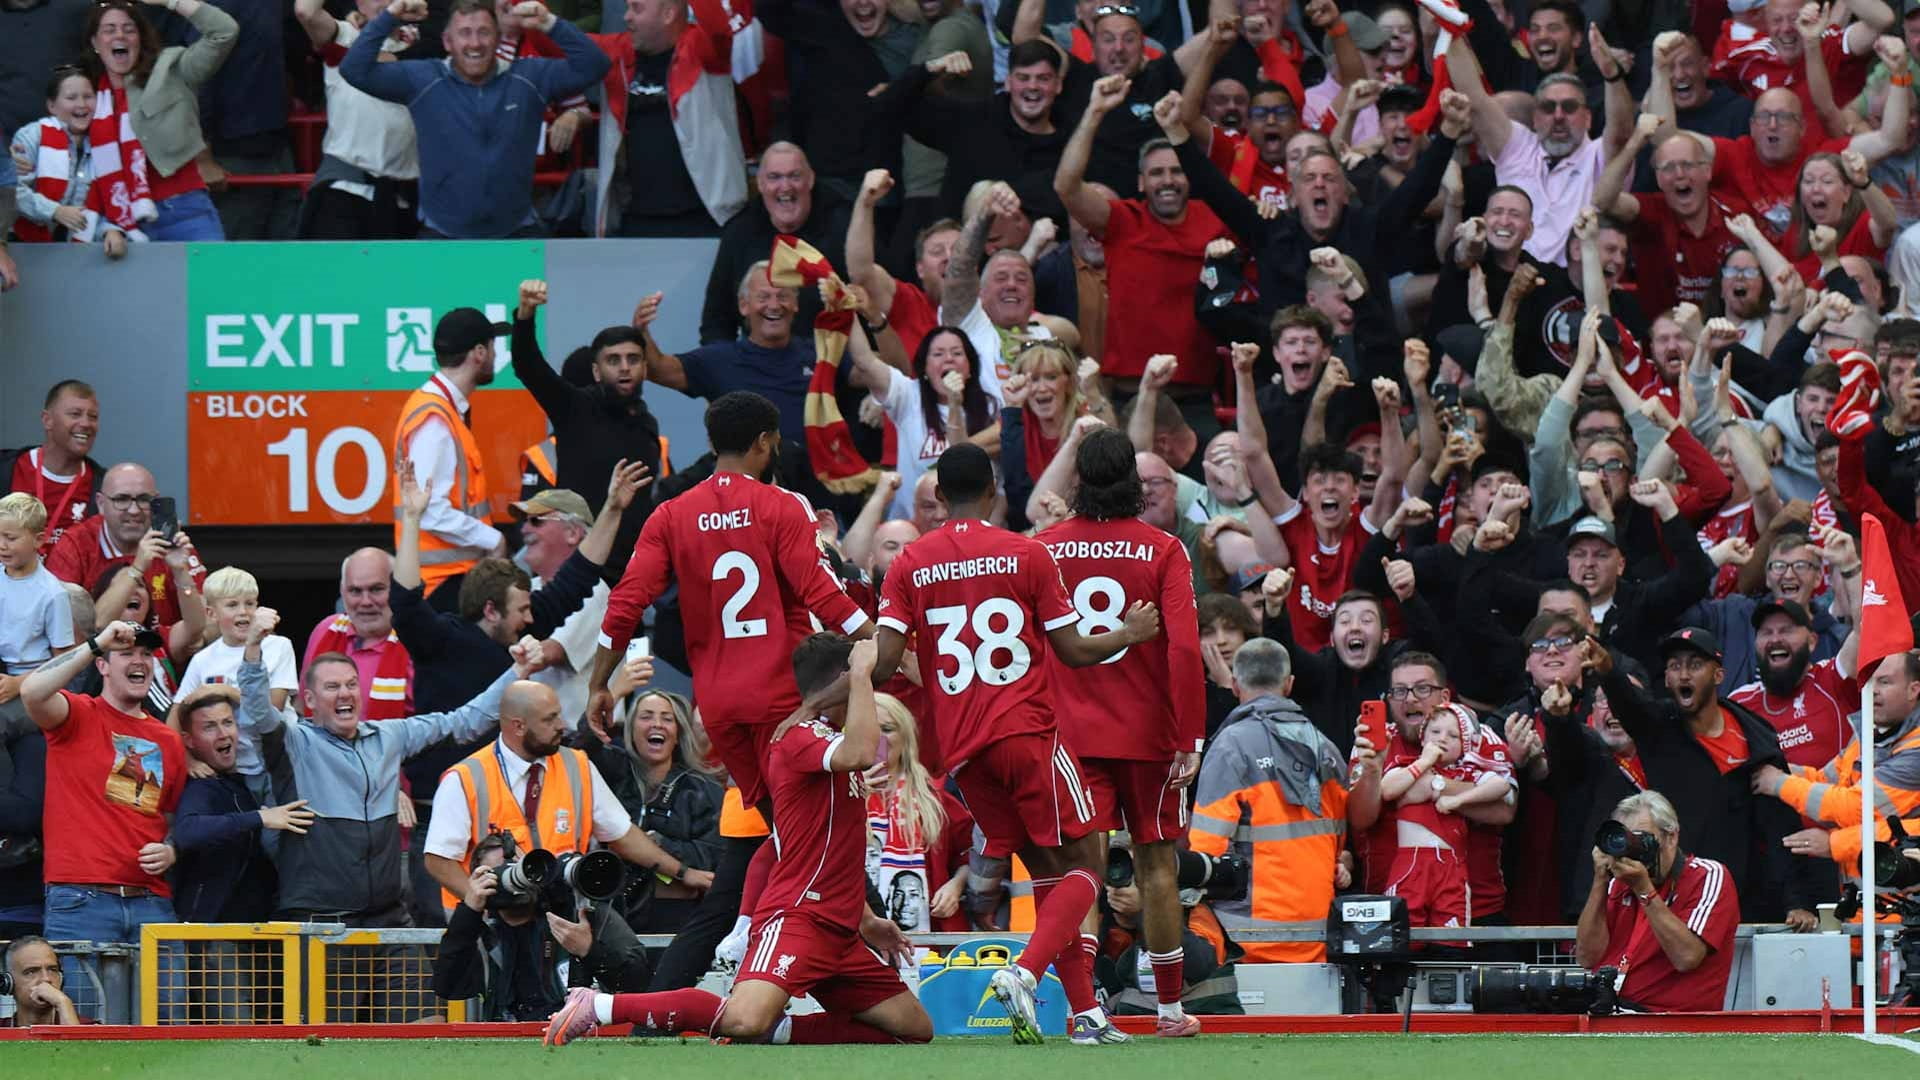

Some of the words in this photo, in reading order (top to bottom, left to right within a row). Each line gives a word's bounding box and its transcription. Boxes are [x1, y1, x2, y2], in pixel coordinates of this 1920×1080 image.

[206, 313, 360, 367] EXIT
[206, 394, 308, 419] BLOCK
[266, 426, 388, 515] 10
[698, 508, 752, 532] GOMEZ
[712, 550, 768, 639] 2
[912, 555, 1018, 588] GRAVENBERCH
[925, 597, 1031, 695] 38
[1073, 575, 1128, 664] 8
[966, 1015, 1012, 1028] Lucozad
